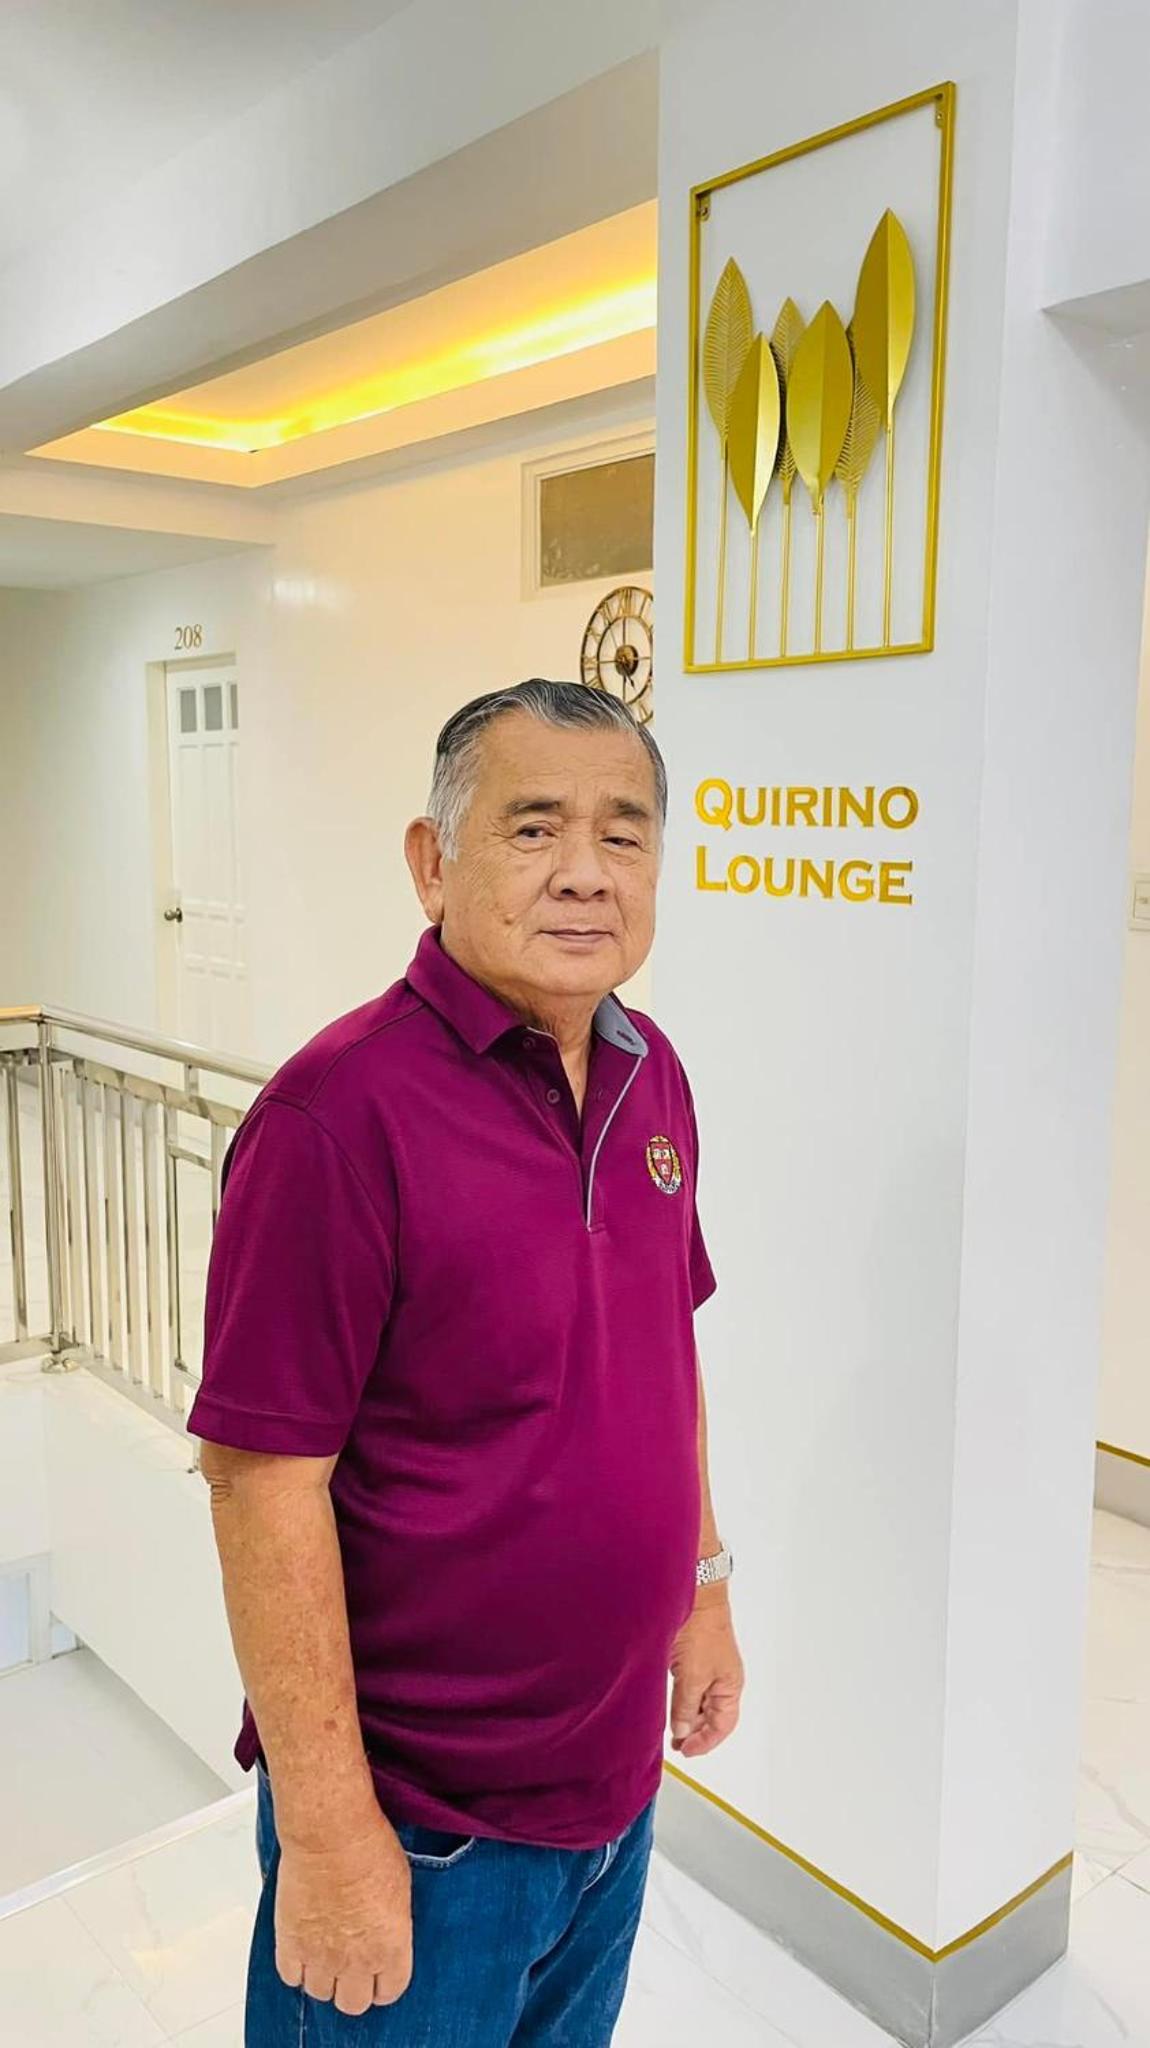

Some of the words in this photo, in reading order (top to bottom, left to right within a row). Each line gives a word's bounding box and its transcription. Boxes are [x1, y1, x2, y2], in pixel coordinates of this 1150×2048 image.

[174, 623, 202, 650] 208
[694, 777, 919, 831] QUIRINO
[695, 845, 913, 905] LOUNGE
